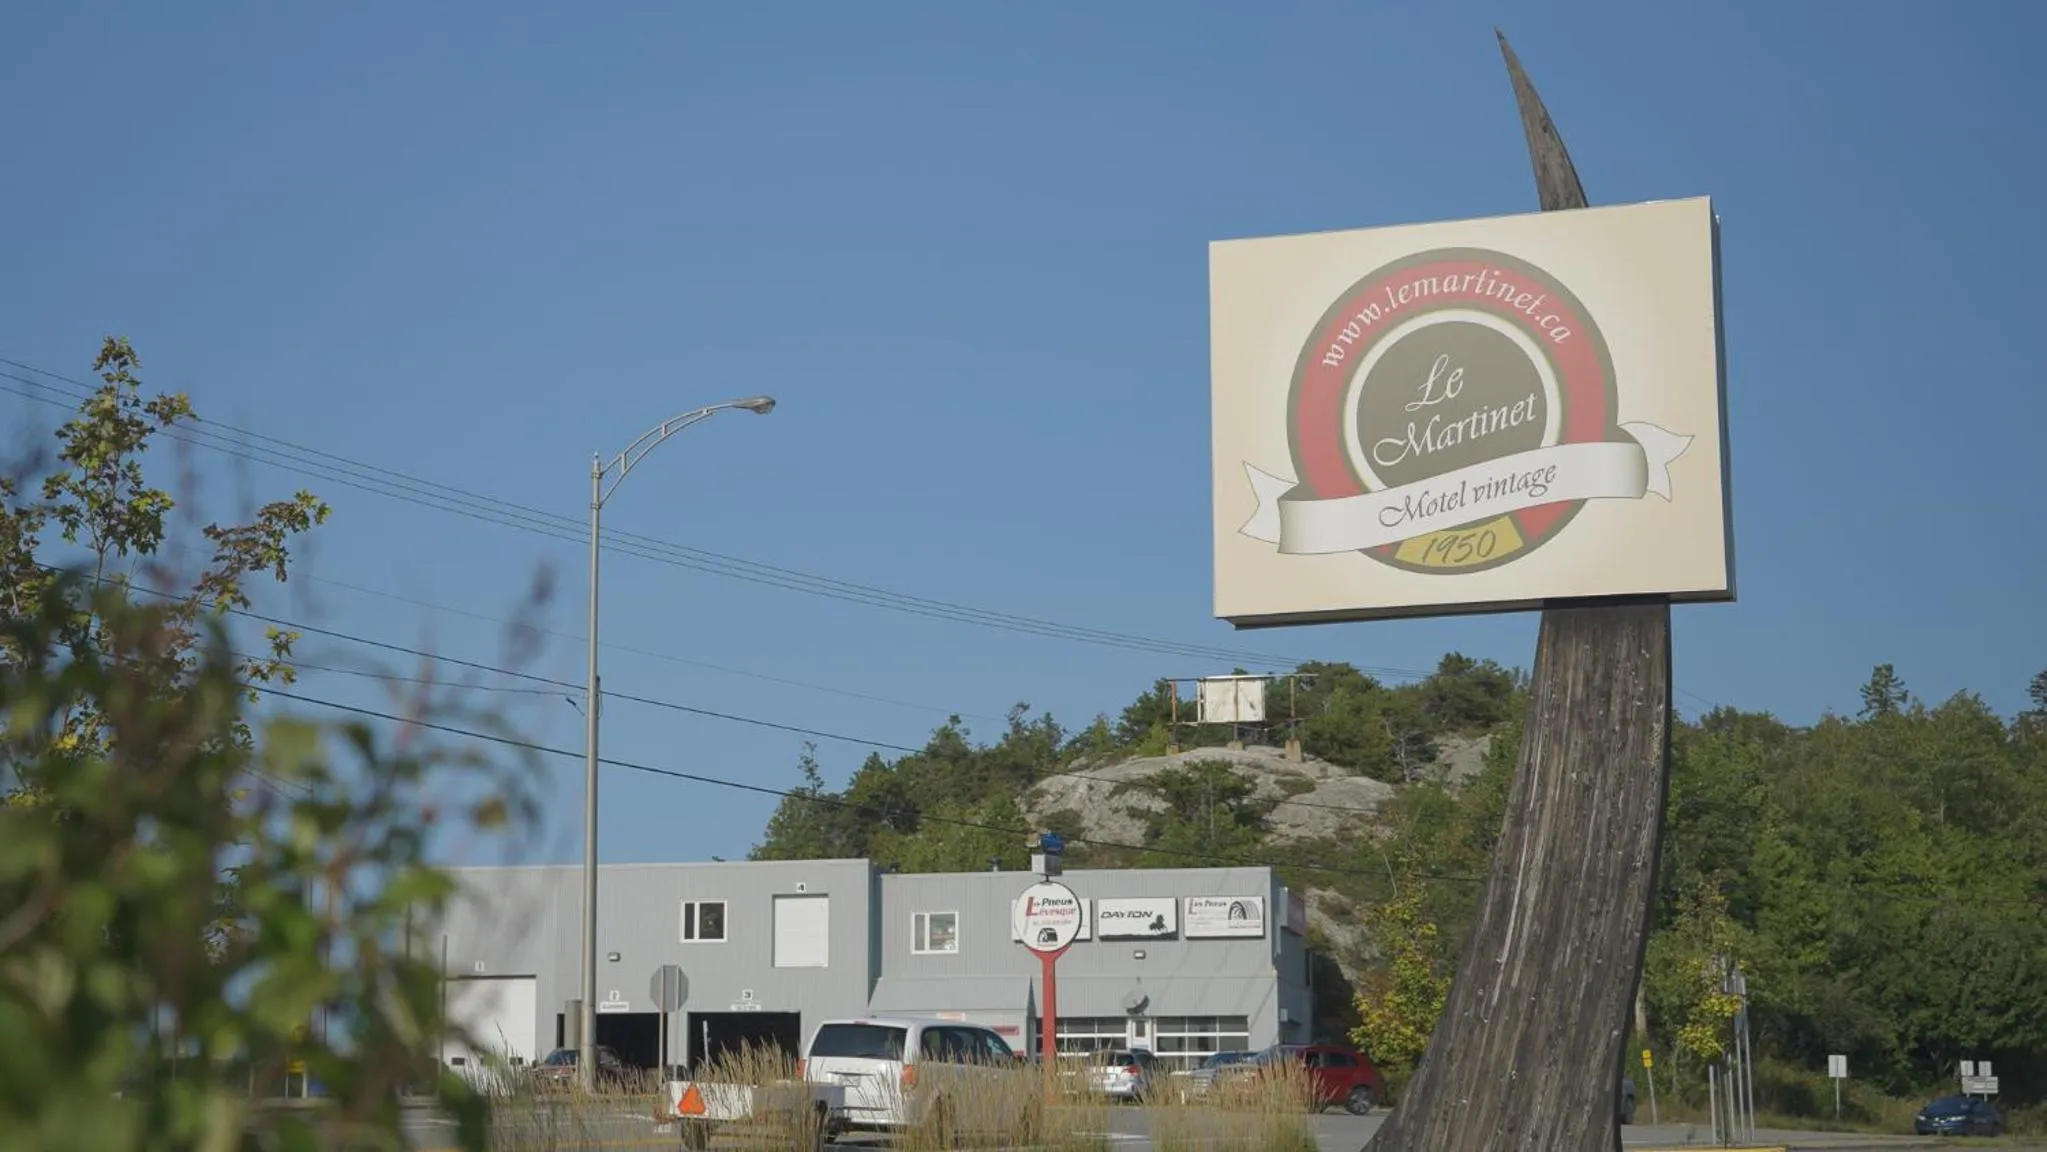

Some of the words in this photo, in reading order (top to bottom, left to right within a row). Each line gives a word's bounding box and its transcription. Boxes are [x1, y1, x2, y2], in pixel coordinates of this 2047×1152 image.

[1322, 269, 1571, 367] www.lemartinet.ca
[1405, 354, 1464, 412] Le
[1373, 393, 1537, 466] Martinet
[1378, 480, 1467, 528] Motel
[1472, 464, 1556, 498] vintage
[1421, 530, 1497, 565] 1950
